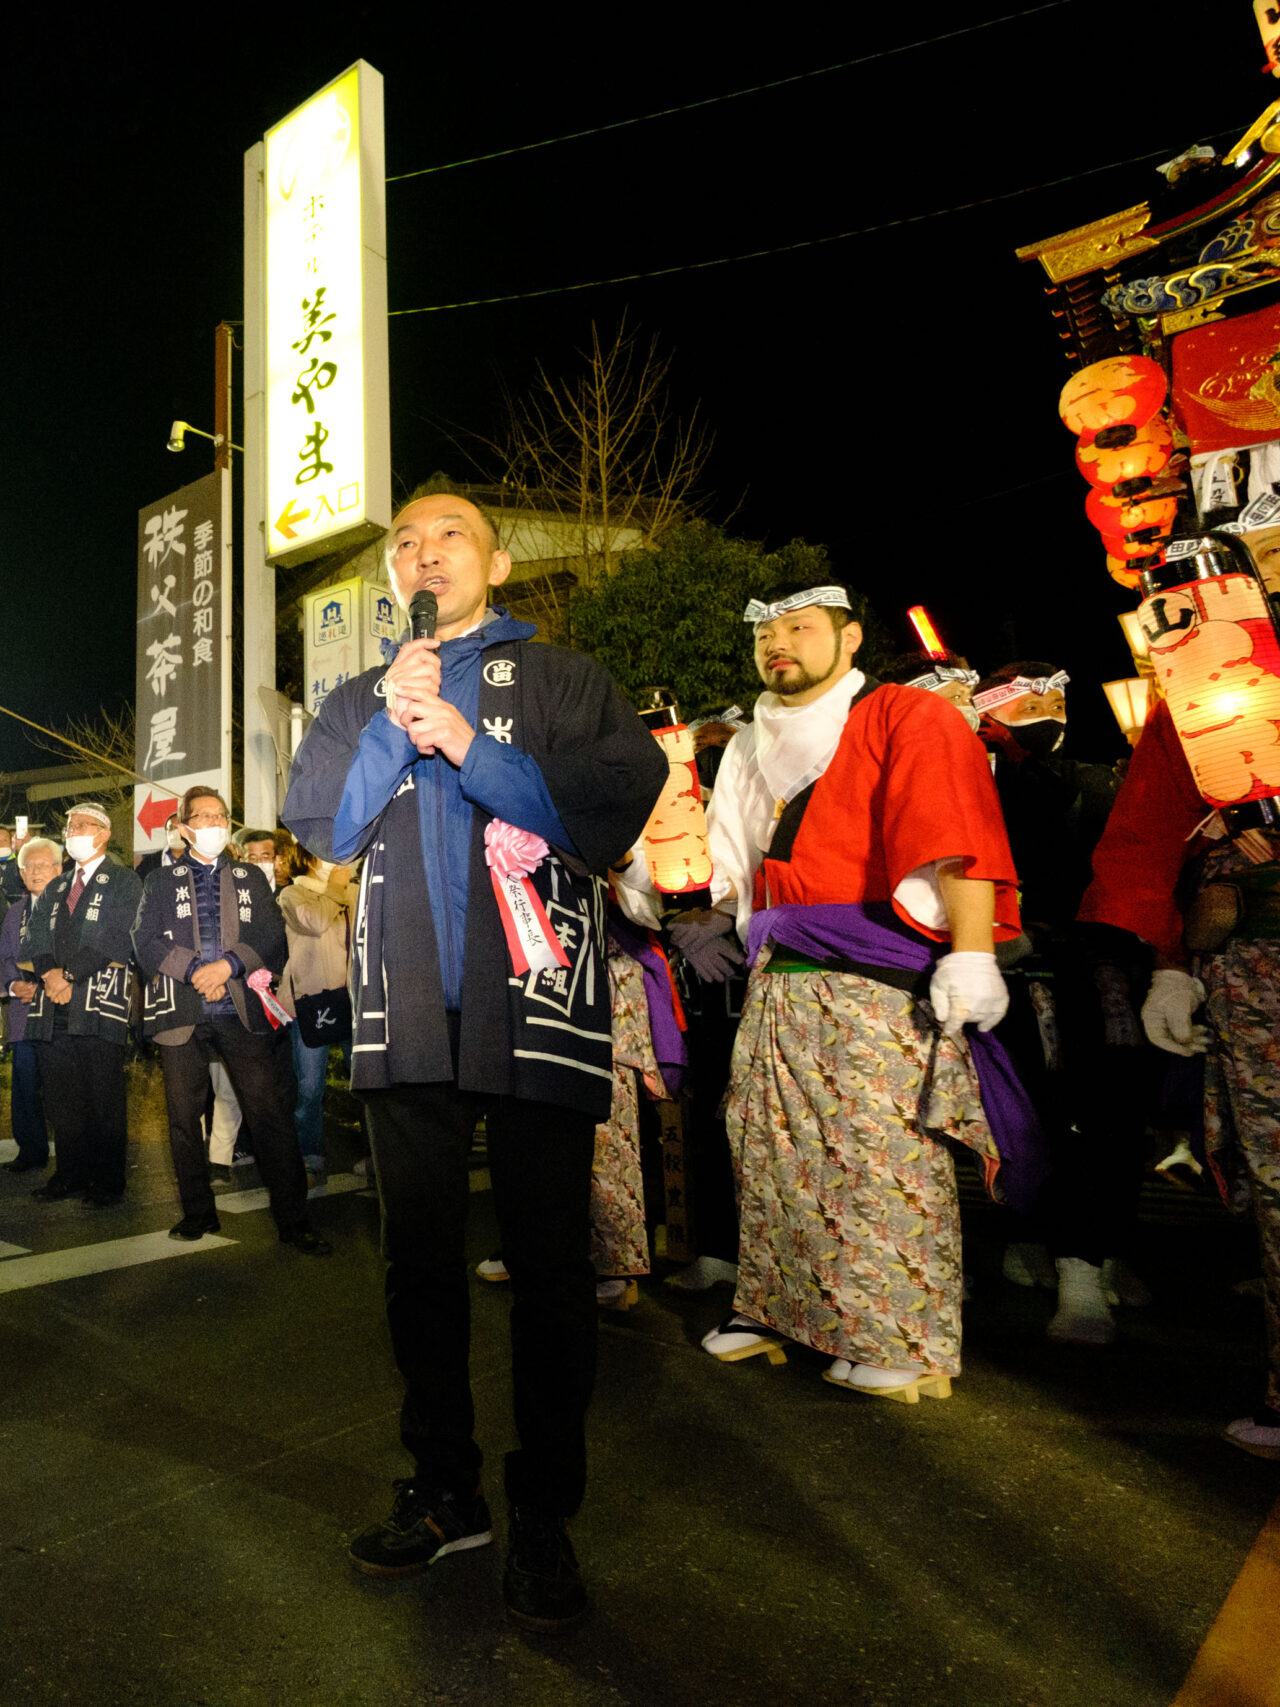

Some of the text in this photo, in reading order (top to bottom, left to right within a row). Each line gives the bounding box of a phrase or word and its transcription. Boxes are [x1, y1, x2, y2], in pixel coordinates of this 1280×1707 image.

[292, 287, 337, 485] 美やま
[313, 481, 360, 525] 入口
[192, 519, 214, 668] 季節の和食
[143, 504, 188, 772] 秩父茶屋
[85, 892, 103, 922] 上組
[175, 886, 192, 919] 本組
[237, 888, 252, 923] 本組
